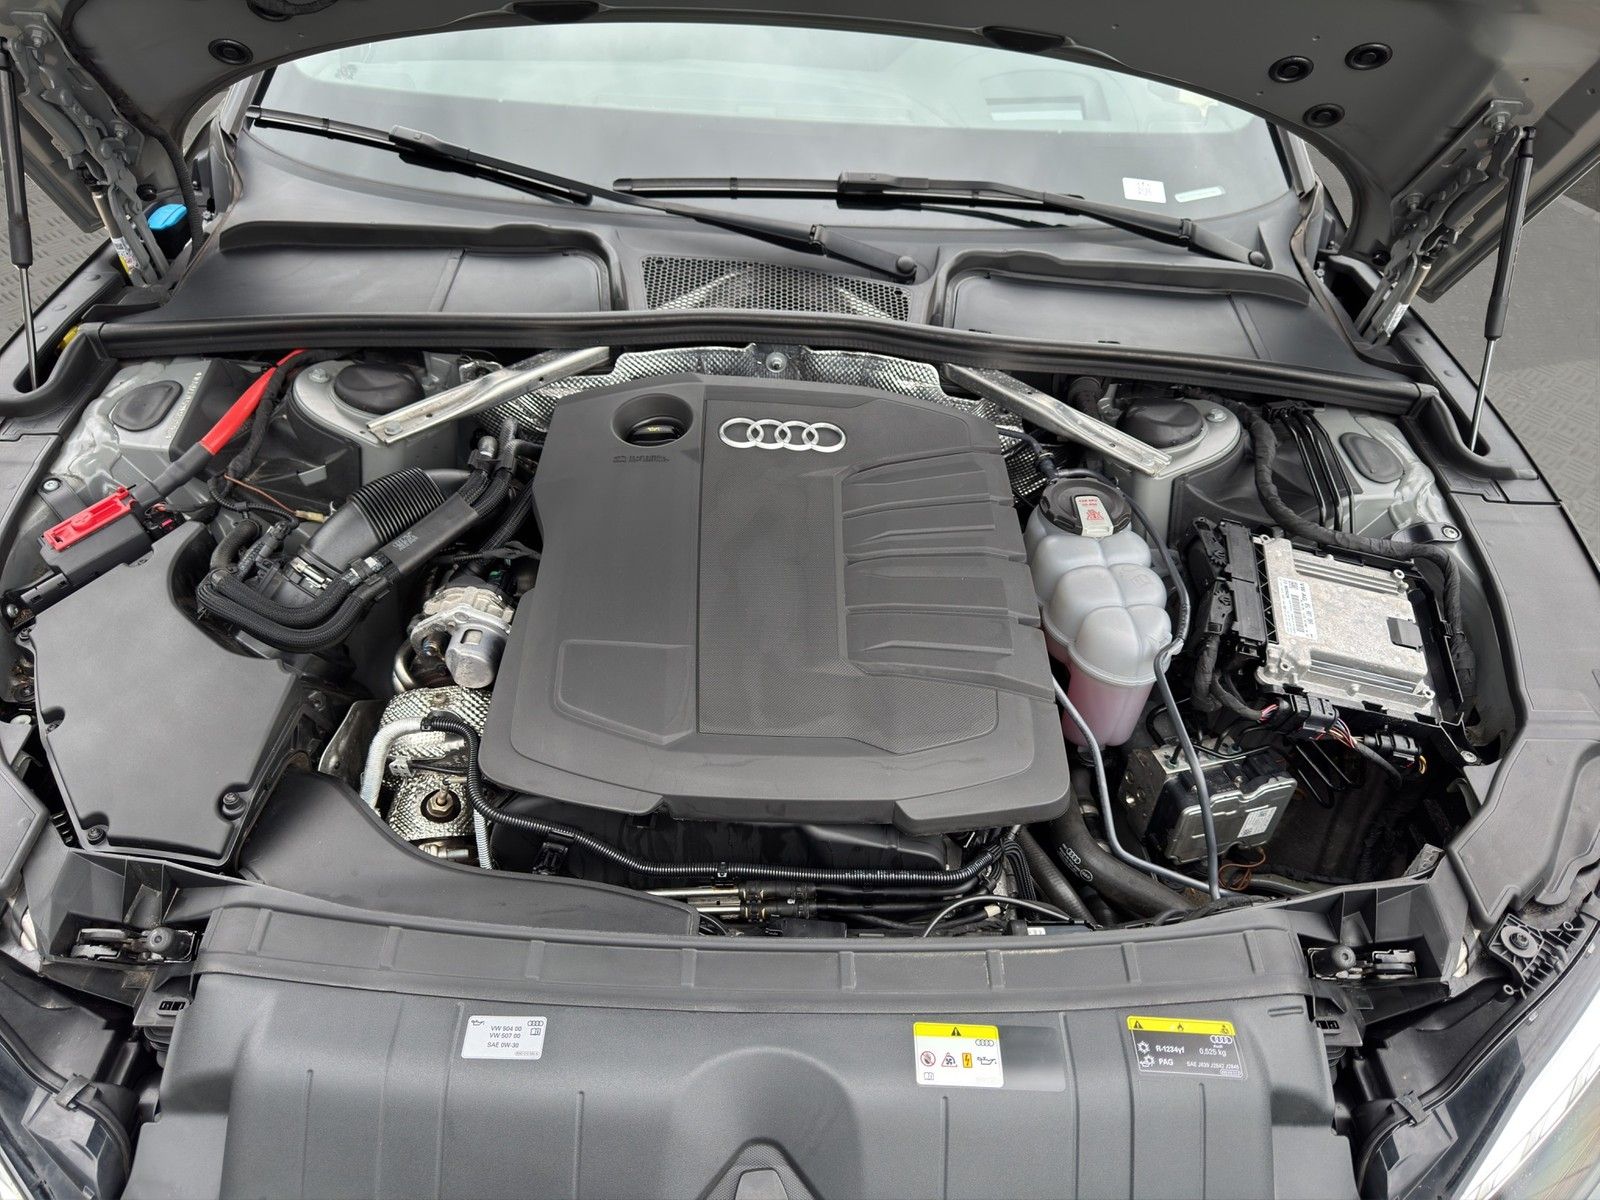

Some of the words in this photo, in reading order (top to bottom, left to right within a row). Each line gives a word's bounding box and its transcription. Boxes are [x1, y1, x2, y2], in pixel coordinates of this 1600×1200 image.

[1155, 1045, 1185, 1054] R-1234yf
[1217, 1049, 1227, 1057] kg
[1159, 1058, 1173, 1066] PAG
